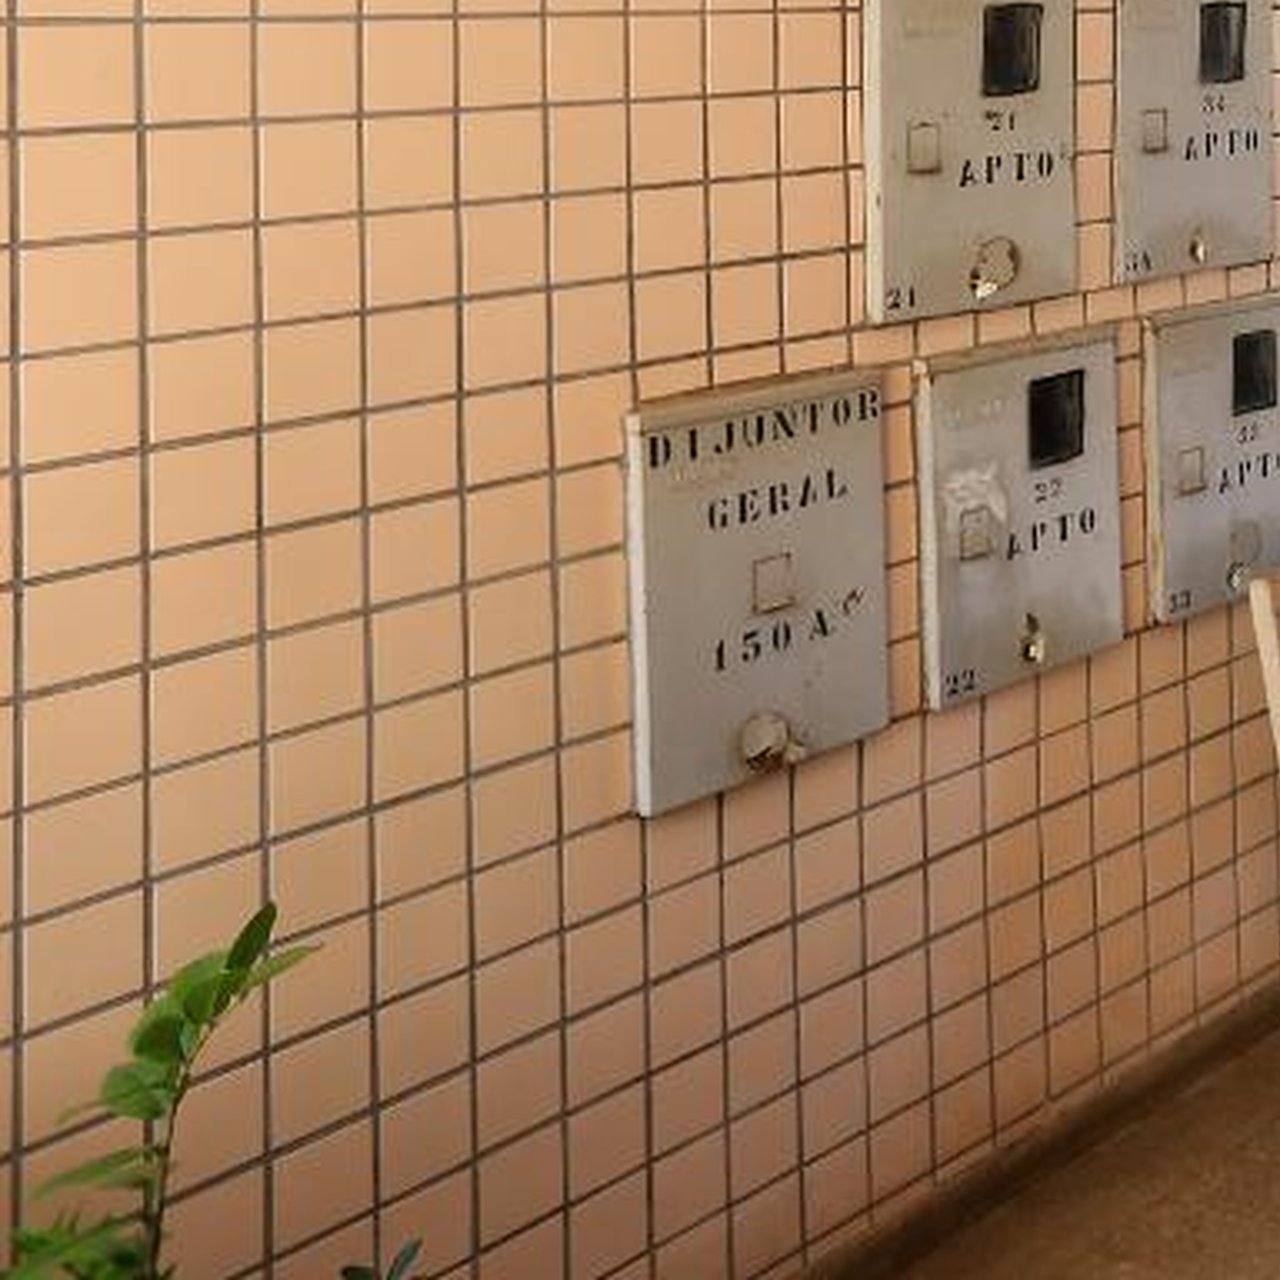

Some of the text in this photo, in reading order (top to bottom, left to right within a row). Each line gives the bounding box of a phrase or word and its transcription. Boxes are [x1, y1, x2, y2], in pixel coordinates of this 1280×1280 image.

[959, 151, 1054, 188] APTO
[1185, 130, 1259, 161] APTO
[649, 388, 879, 470] DIJUNTOR
[707, 468, 848, 530] GERAL
[1006, 507, 1095, 561] APTO
